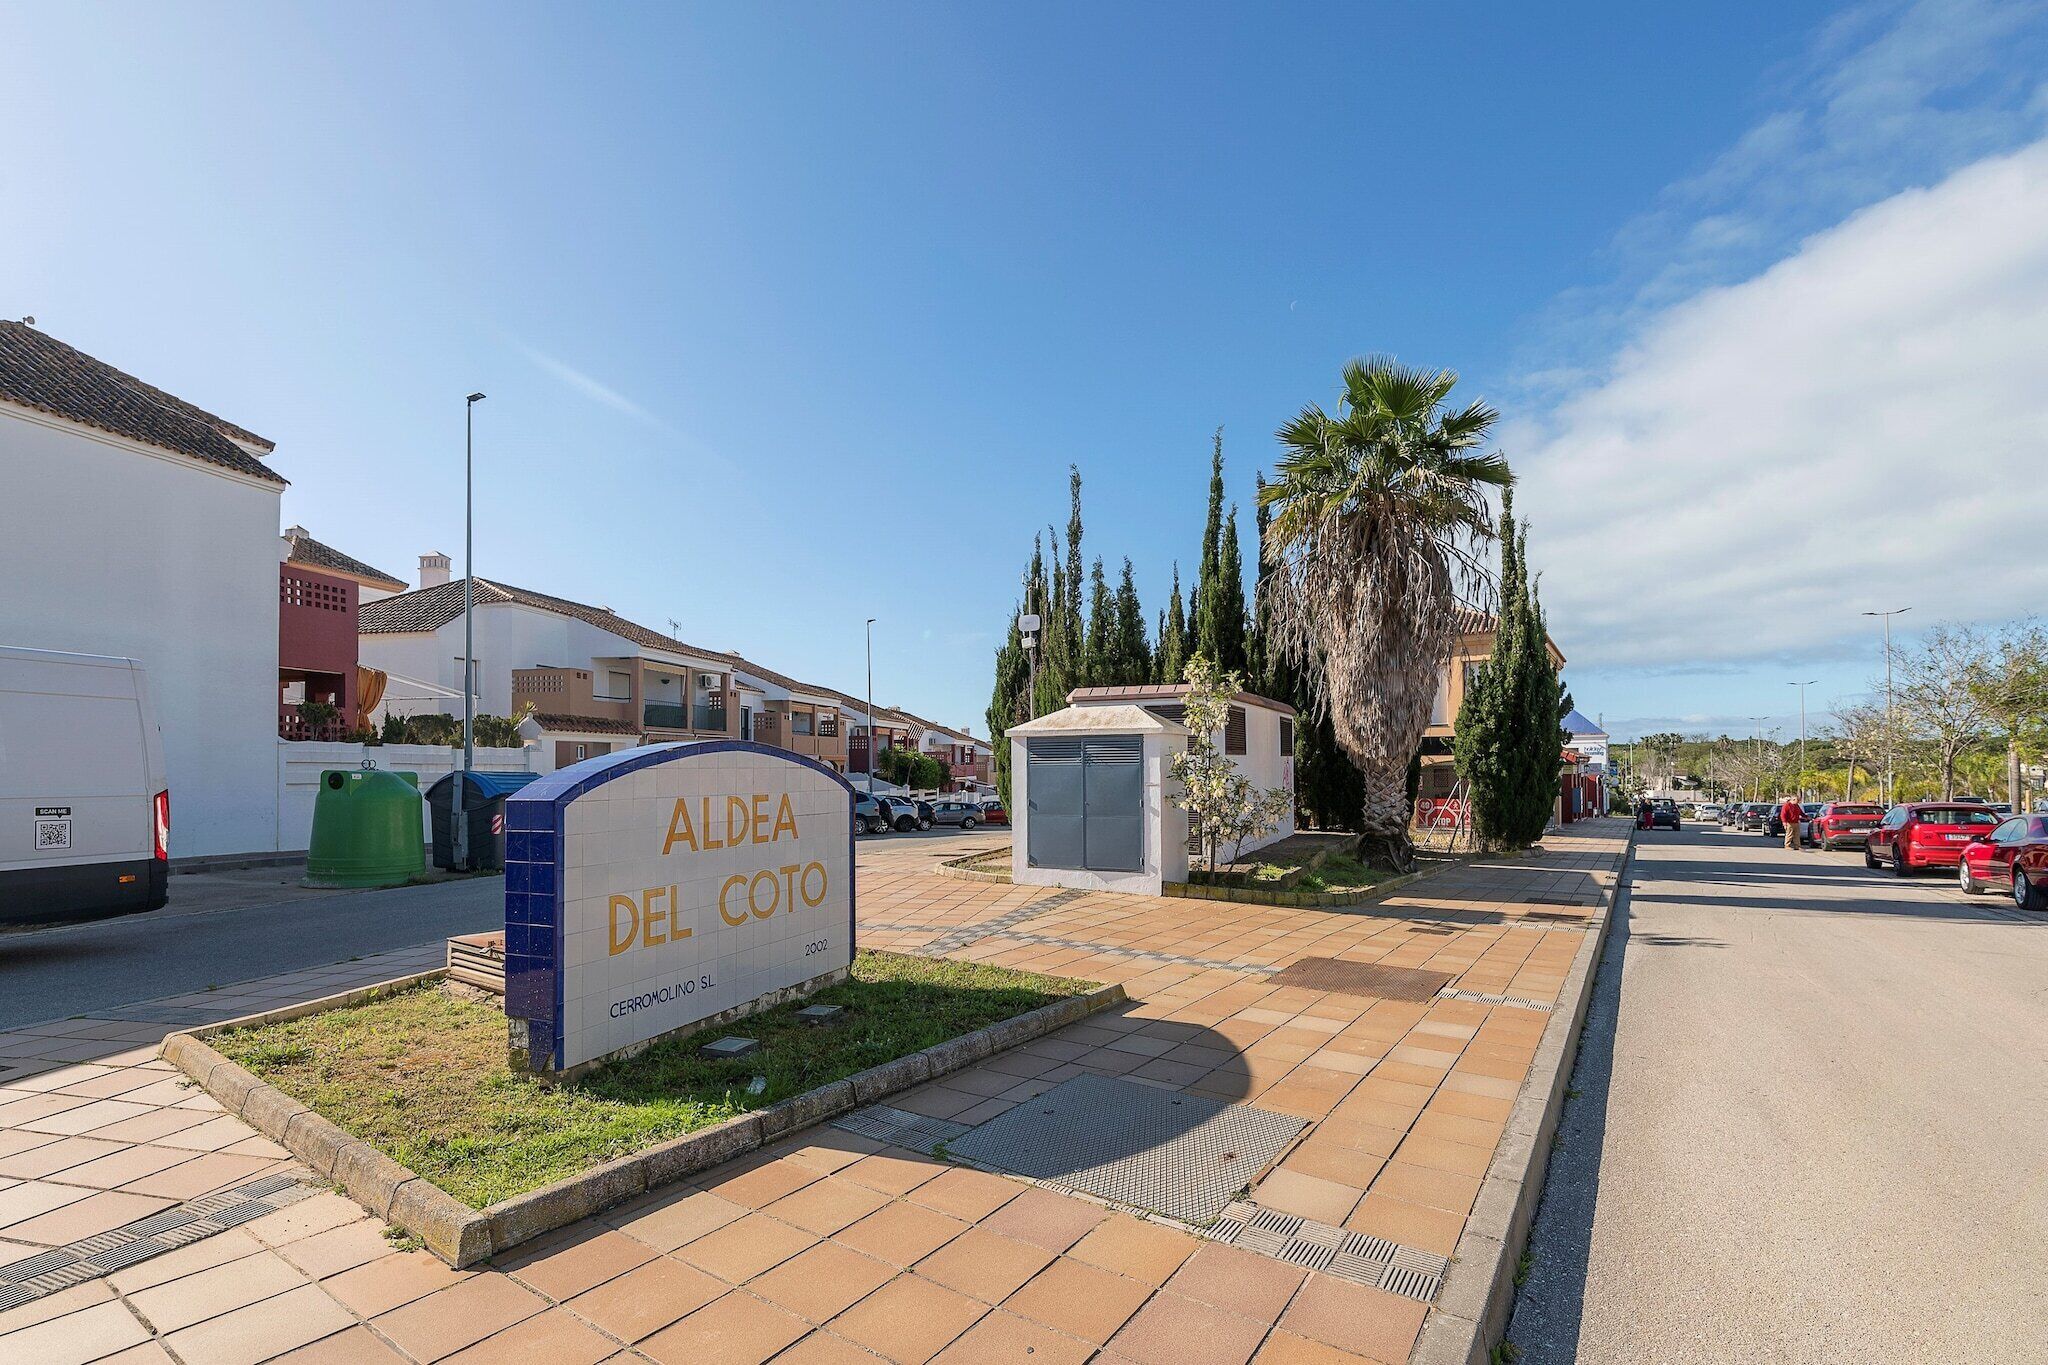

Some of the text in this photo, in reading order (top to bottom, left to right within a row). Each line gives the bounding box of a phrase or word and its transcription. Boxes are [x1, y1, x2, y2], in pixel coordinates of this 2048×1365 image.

[662, 793, 799, 855] ALDEA
[1432, 818, 1451, 826] STOP
[608, 861, 829, 957] DEL COTO
[805, 938, 829, 957] 2002
[610, 980, 696, 1019] CERROMOLINO
